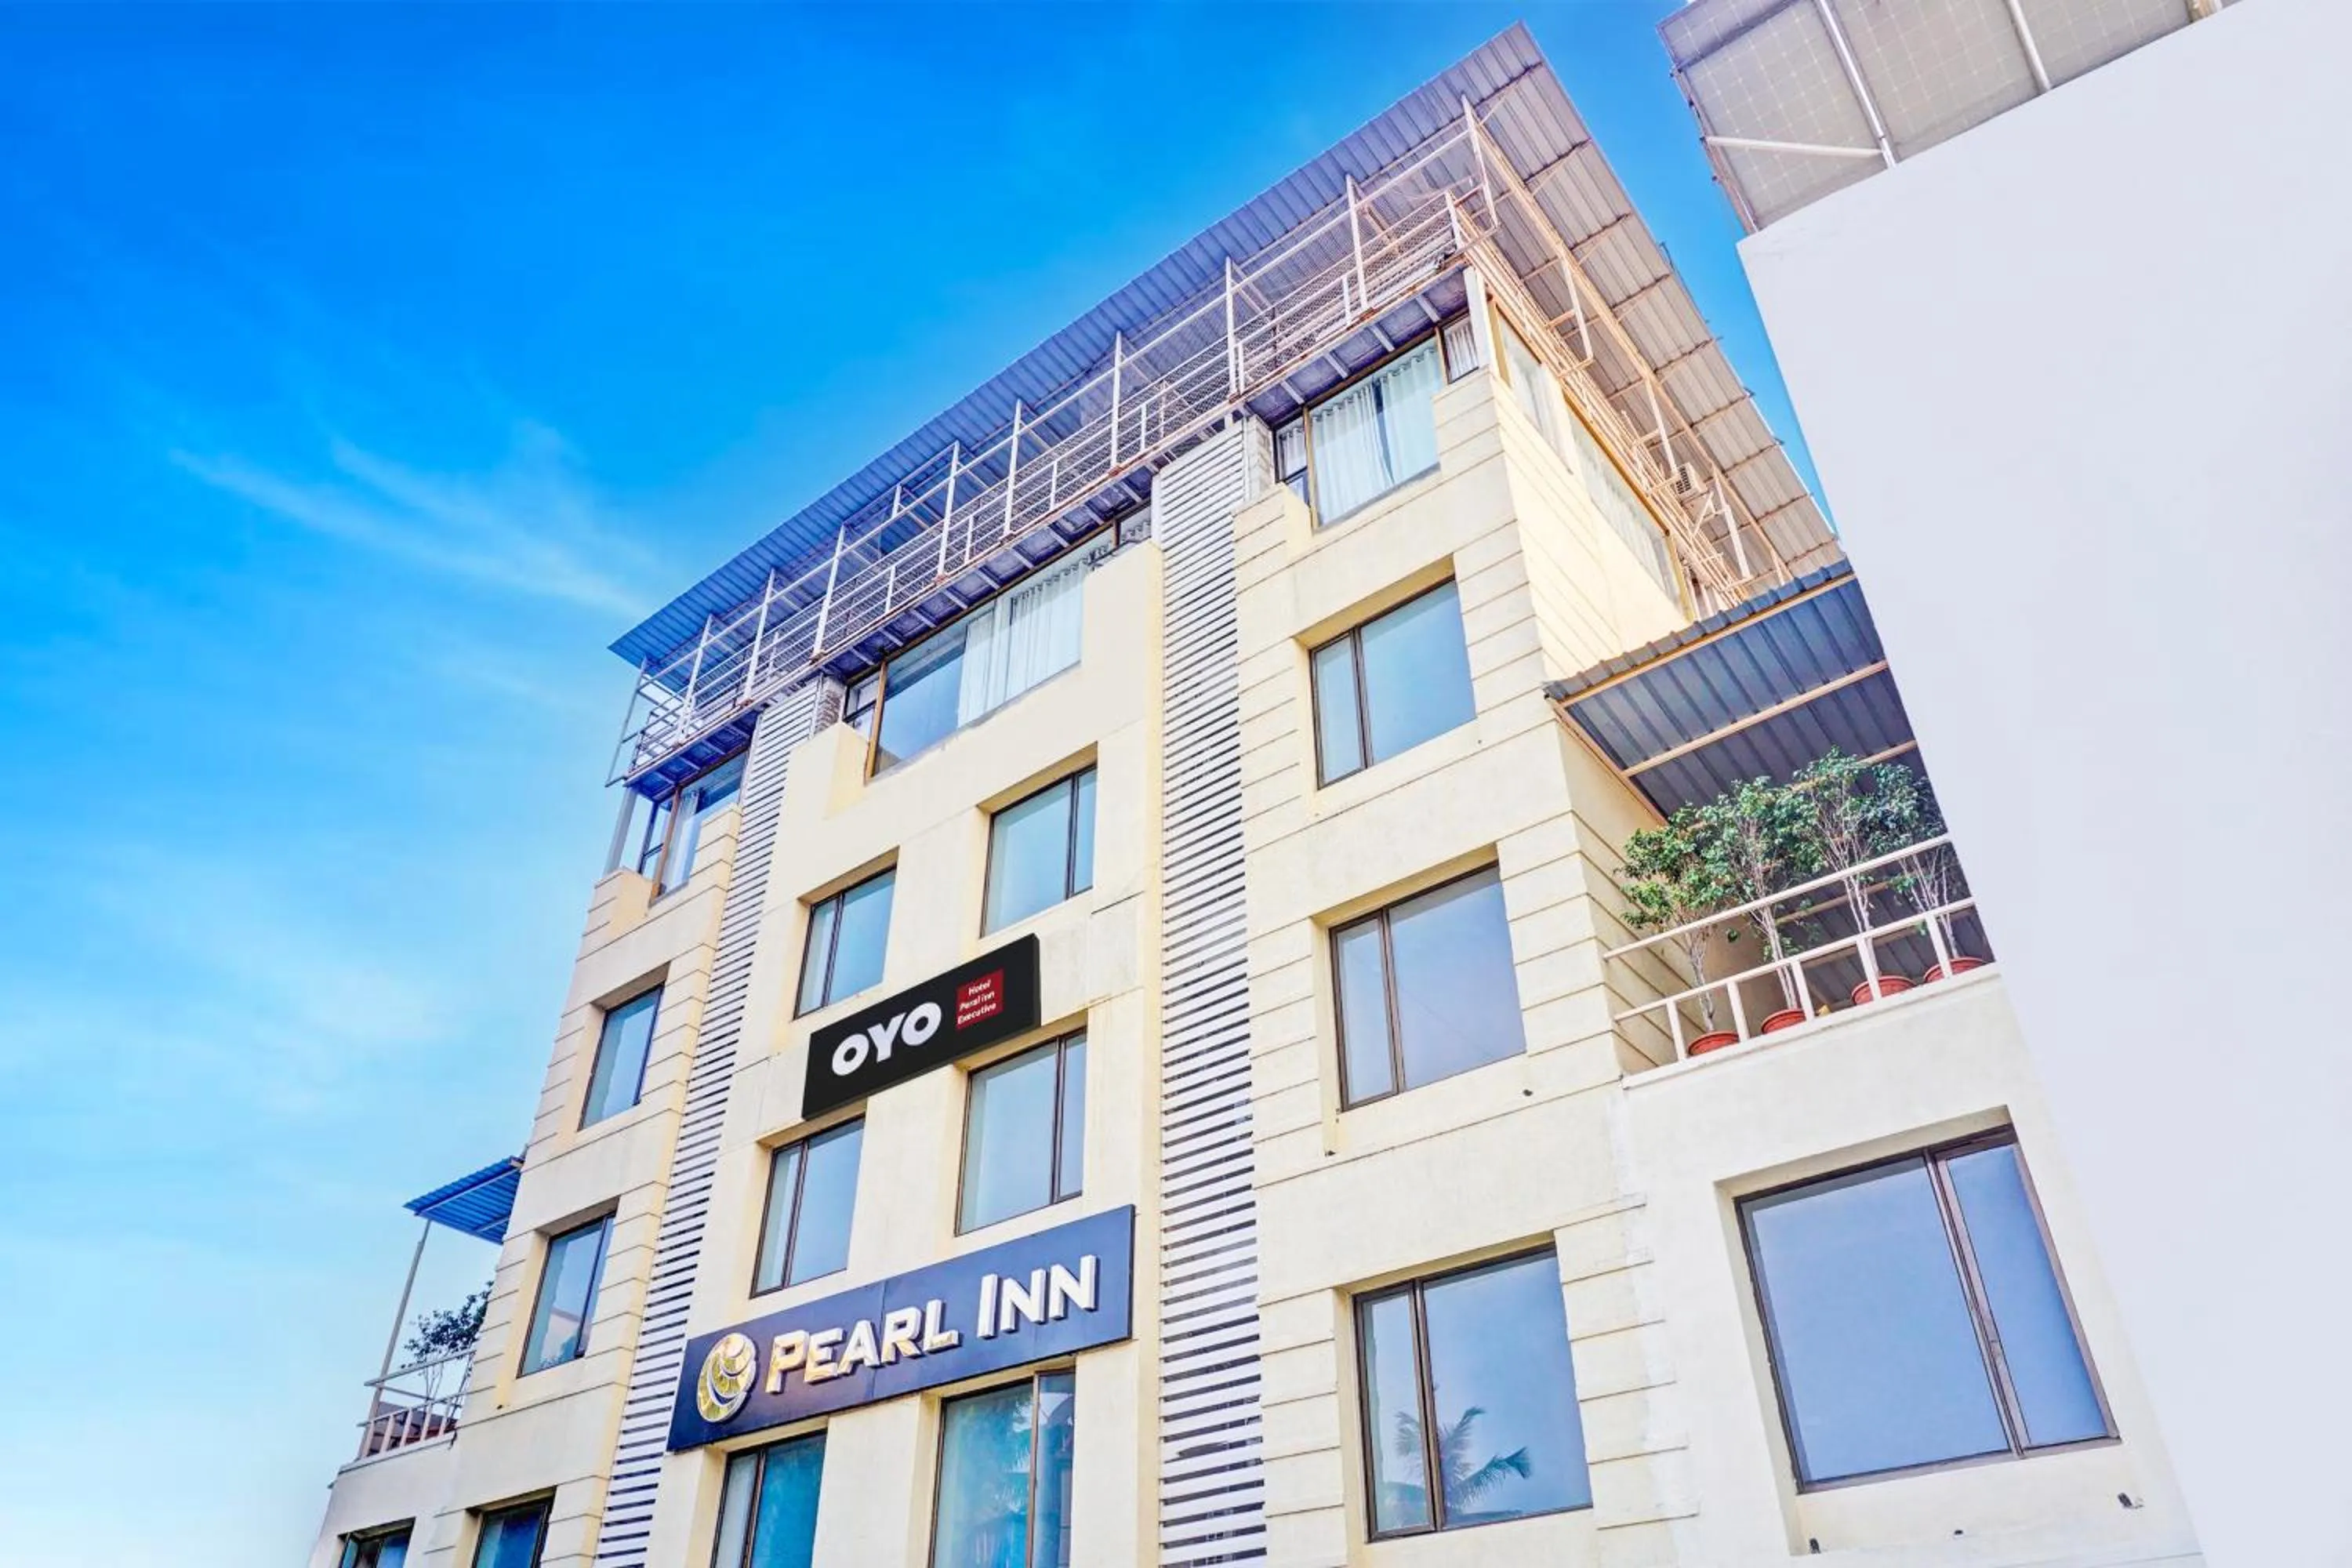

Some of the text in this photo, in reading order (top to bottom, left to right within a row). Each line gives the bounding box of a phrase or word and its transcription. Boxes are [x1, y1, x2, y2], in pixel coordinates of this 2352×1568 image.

[968, 979, 991, 996] Hotel
[957, 1003, 996, 1025] Executive
[832, 1002, 942, 1076] OYO
[765, 1254, 1099, 1393] PEARL INN
